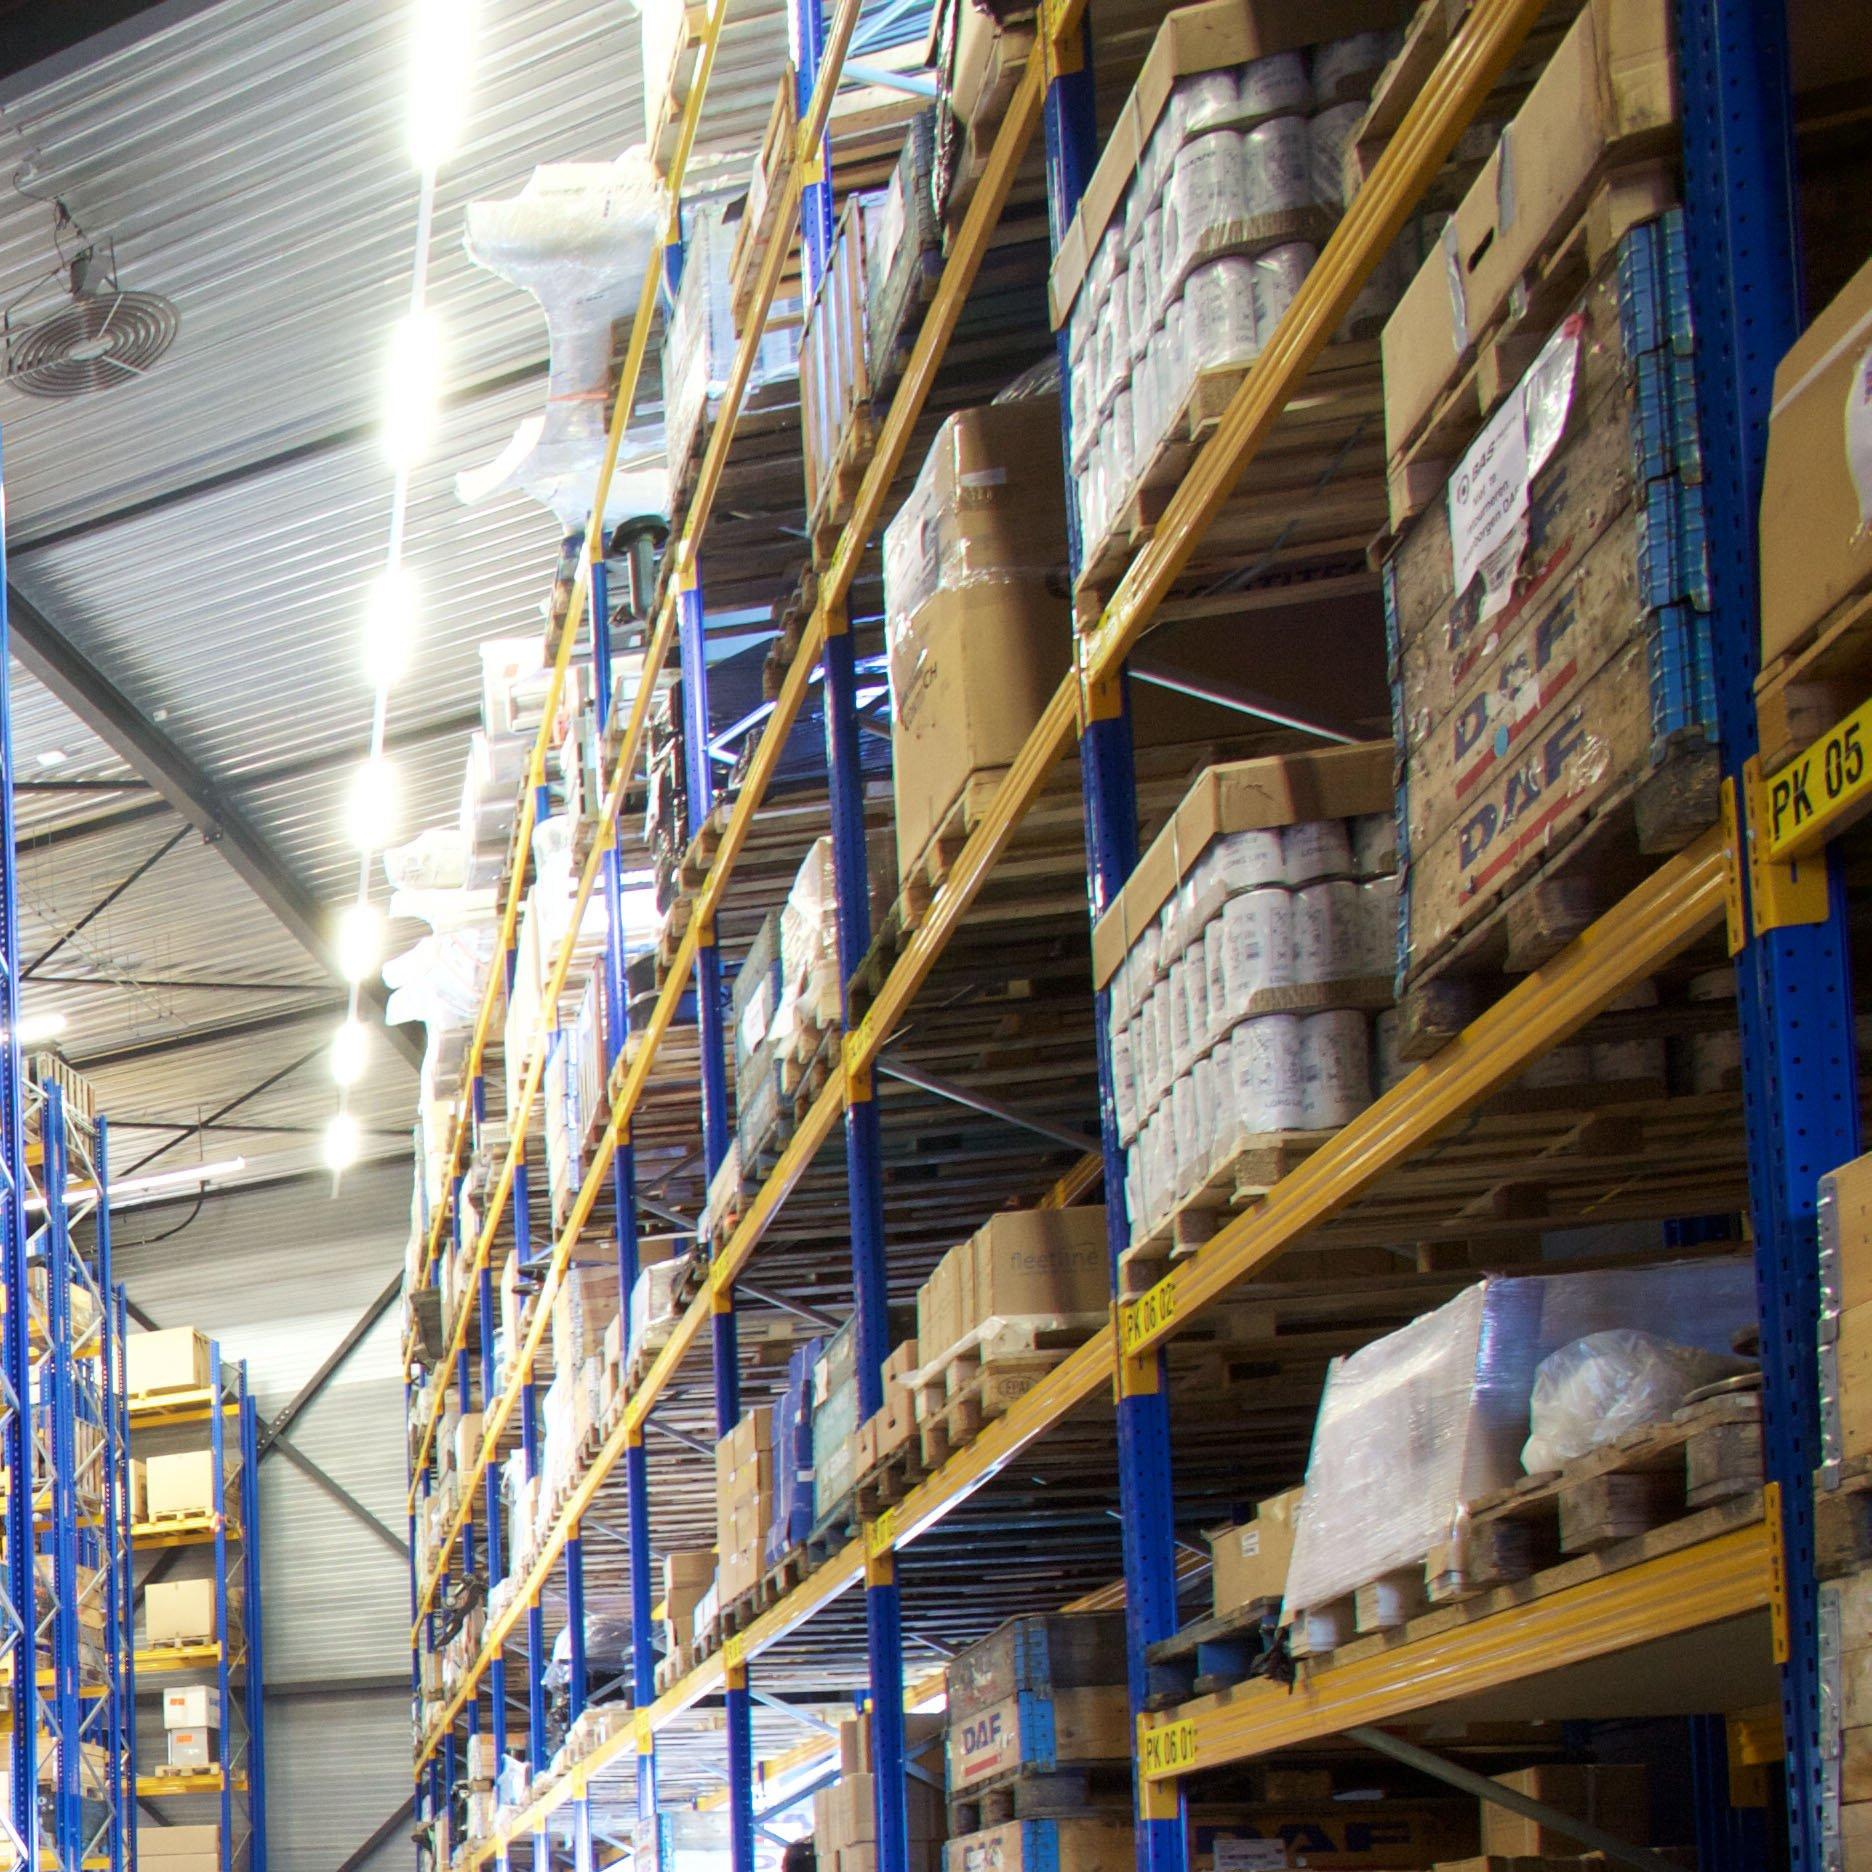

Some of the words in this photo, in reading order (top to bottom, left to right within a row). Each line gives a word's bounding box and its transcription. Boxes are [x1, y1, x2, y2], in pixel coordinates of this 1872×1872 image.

[1460, 704, 1587, 874] DAF
[1771, 759, 1814, 842] PK
[1825, 721, 1864, 799] 05
[961, 1711, 1002, 1757] DAF
[1145, 1735, 1162, 1767] PK
[1163, 1729, 1177, 1765] 06
[1179, 1727, 1194, 1761] 01
